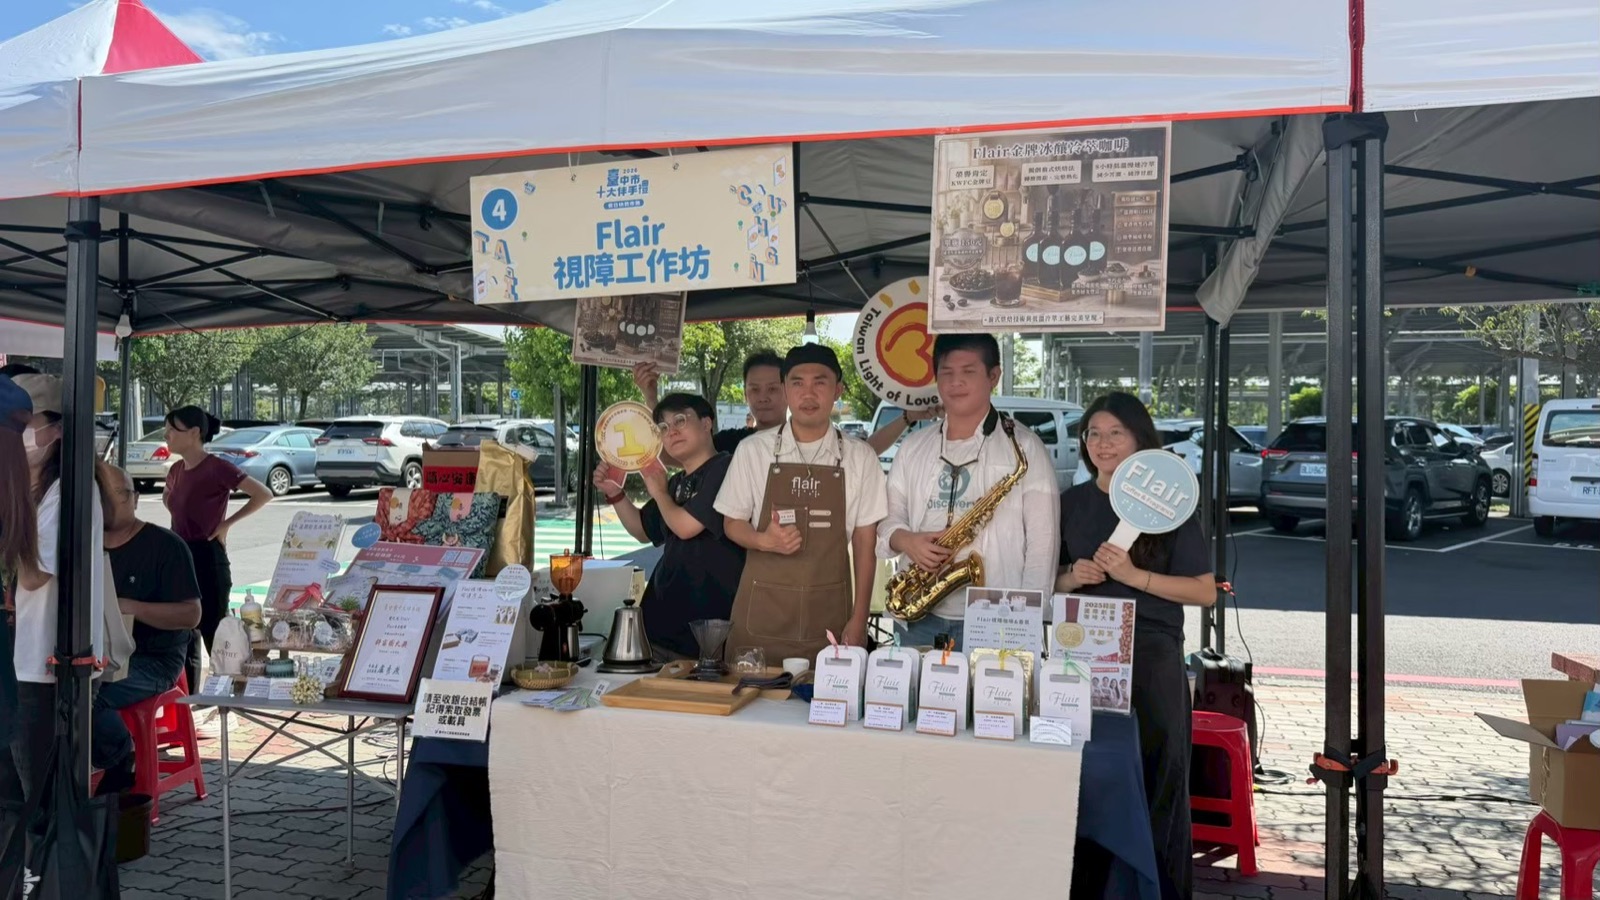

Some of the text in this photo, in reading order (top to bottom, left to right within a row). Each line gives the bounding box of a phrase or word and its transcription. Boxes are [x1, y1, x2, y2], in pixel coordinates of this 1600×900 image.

[596, 180, 650, 199] 十大伴手禮
[491, 198, 507, 222] 4
[596, 215, 666, 250] Flair
[553, 244, 711, 290] 視障工作坊
[857, 307, 939, 406] Taiwan Light of Love
[613, 421, 646, 458] 1
[791, 476, 821, 490] flair
[1125, 460, 1190, 507] Flair
[927, 499, 976, 510] Discver
[823, 673, 850, 687] Flair
[873, 674, 900, 688] Flair
[928, 680, 957, 694] Flair
[422, 692, 488, 707] 請至收銀台結帳
[983, 685, 1013, 699] Flair
[1049, 691, 1079, 706] Flair
[425, 703, 482, 717] 記得索取發票
[437, 715, 466, 727] 或載具
